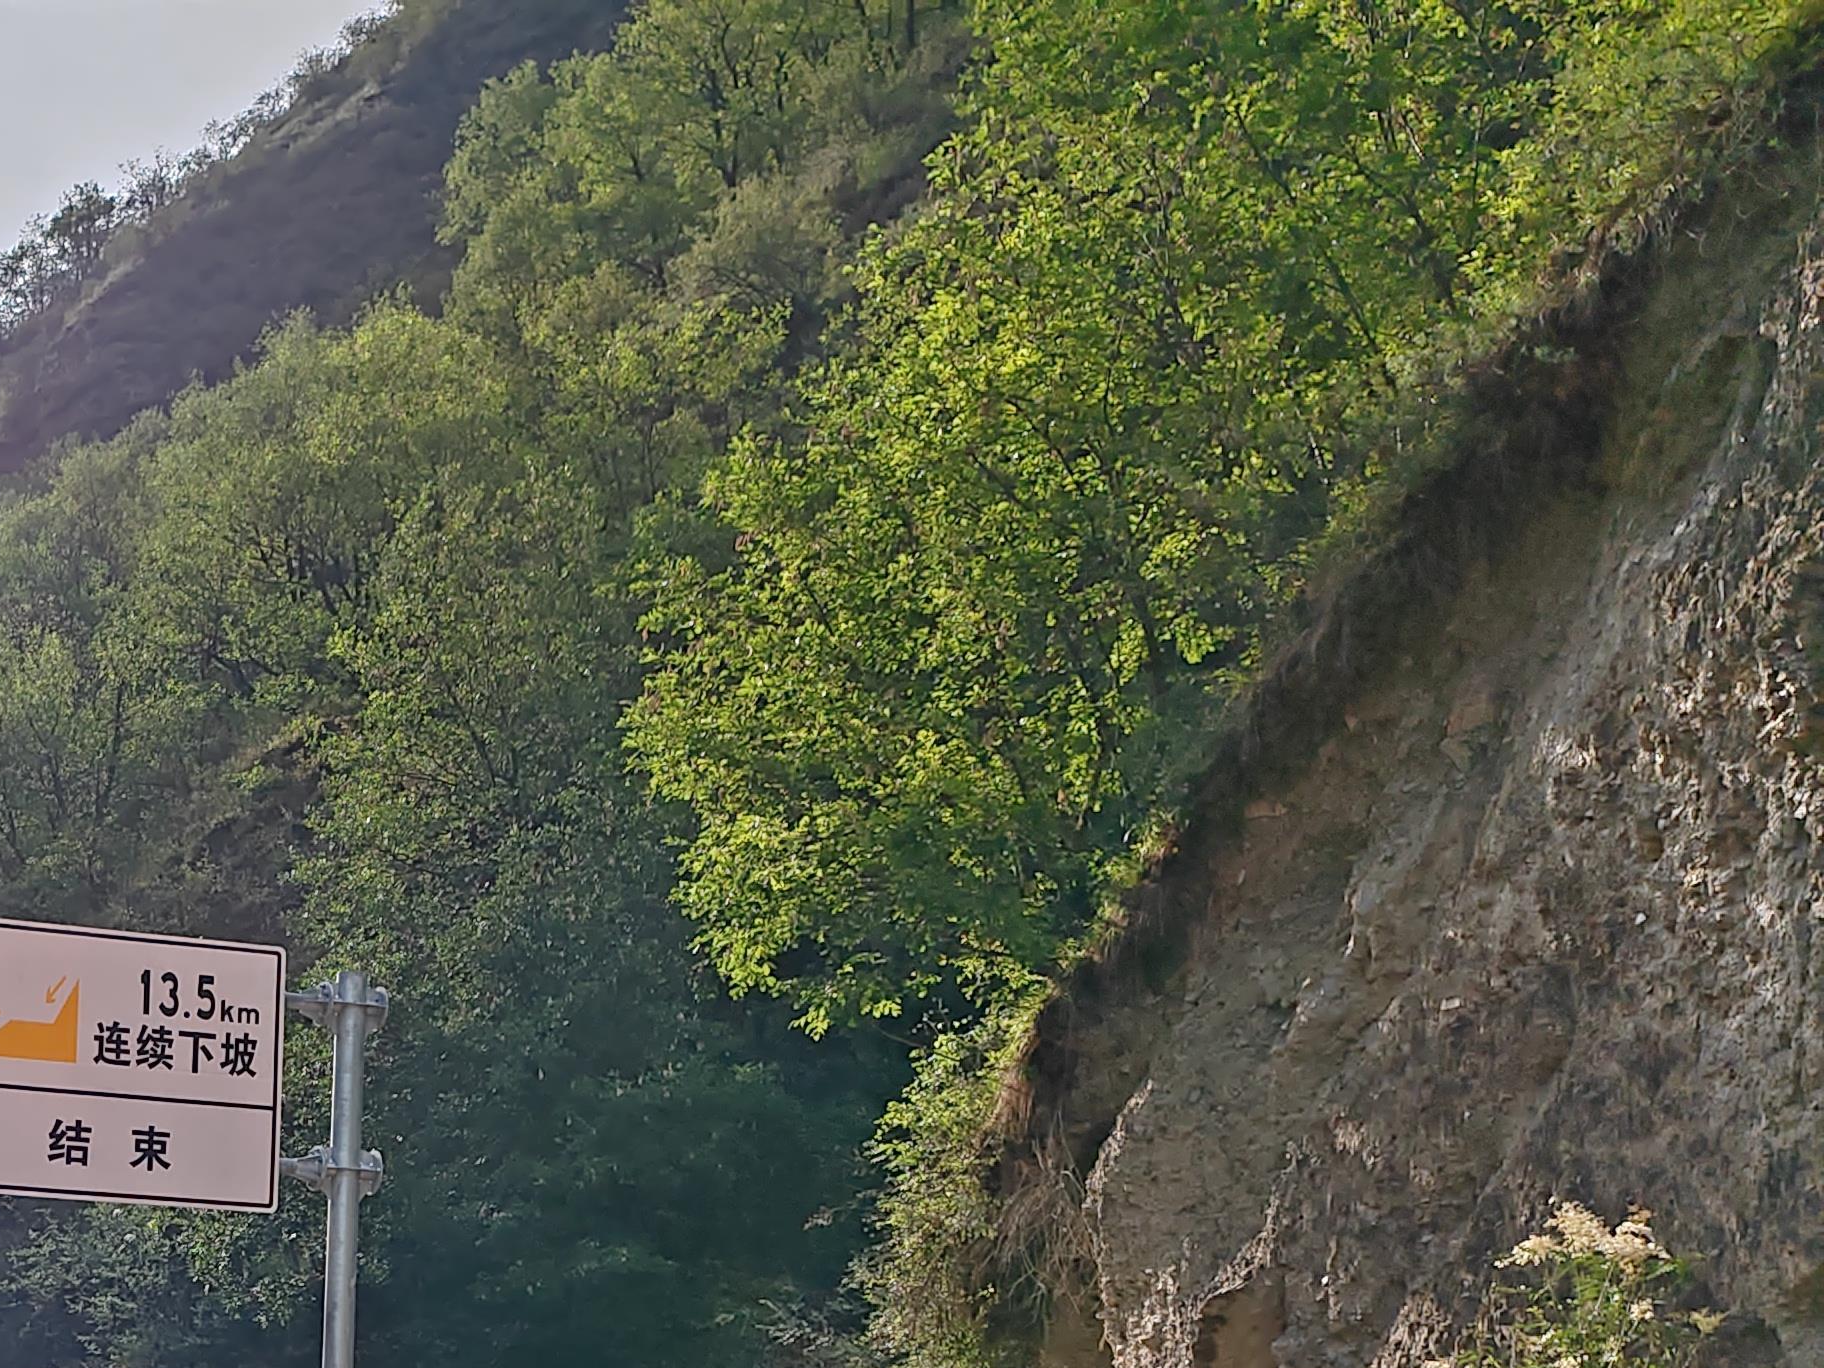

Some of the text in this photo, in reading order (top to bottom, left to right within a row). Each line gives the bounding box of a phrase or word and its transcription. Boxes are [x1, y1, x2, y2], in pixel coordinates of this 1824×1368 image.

[140, 969, 261, 1025] 13.5km
[92, 1021, 259, 1078] 连续下坡
[47, 1119, 172, 1172] 结束
